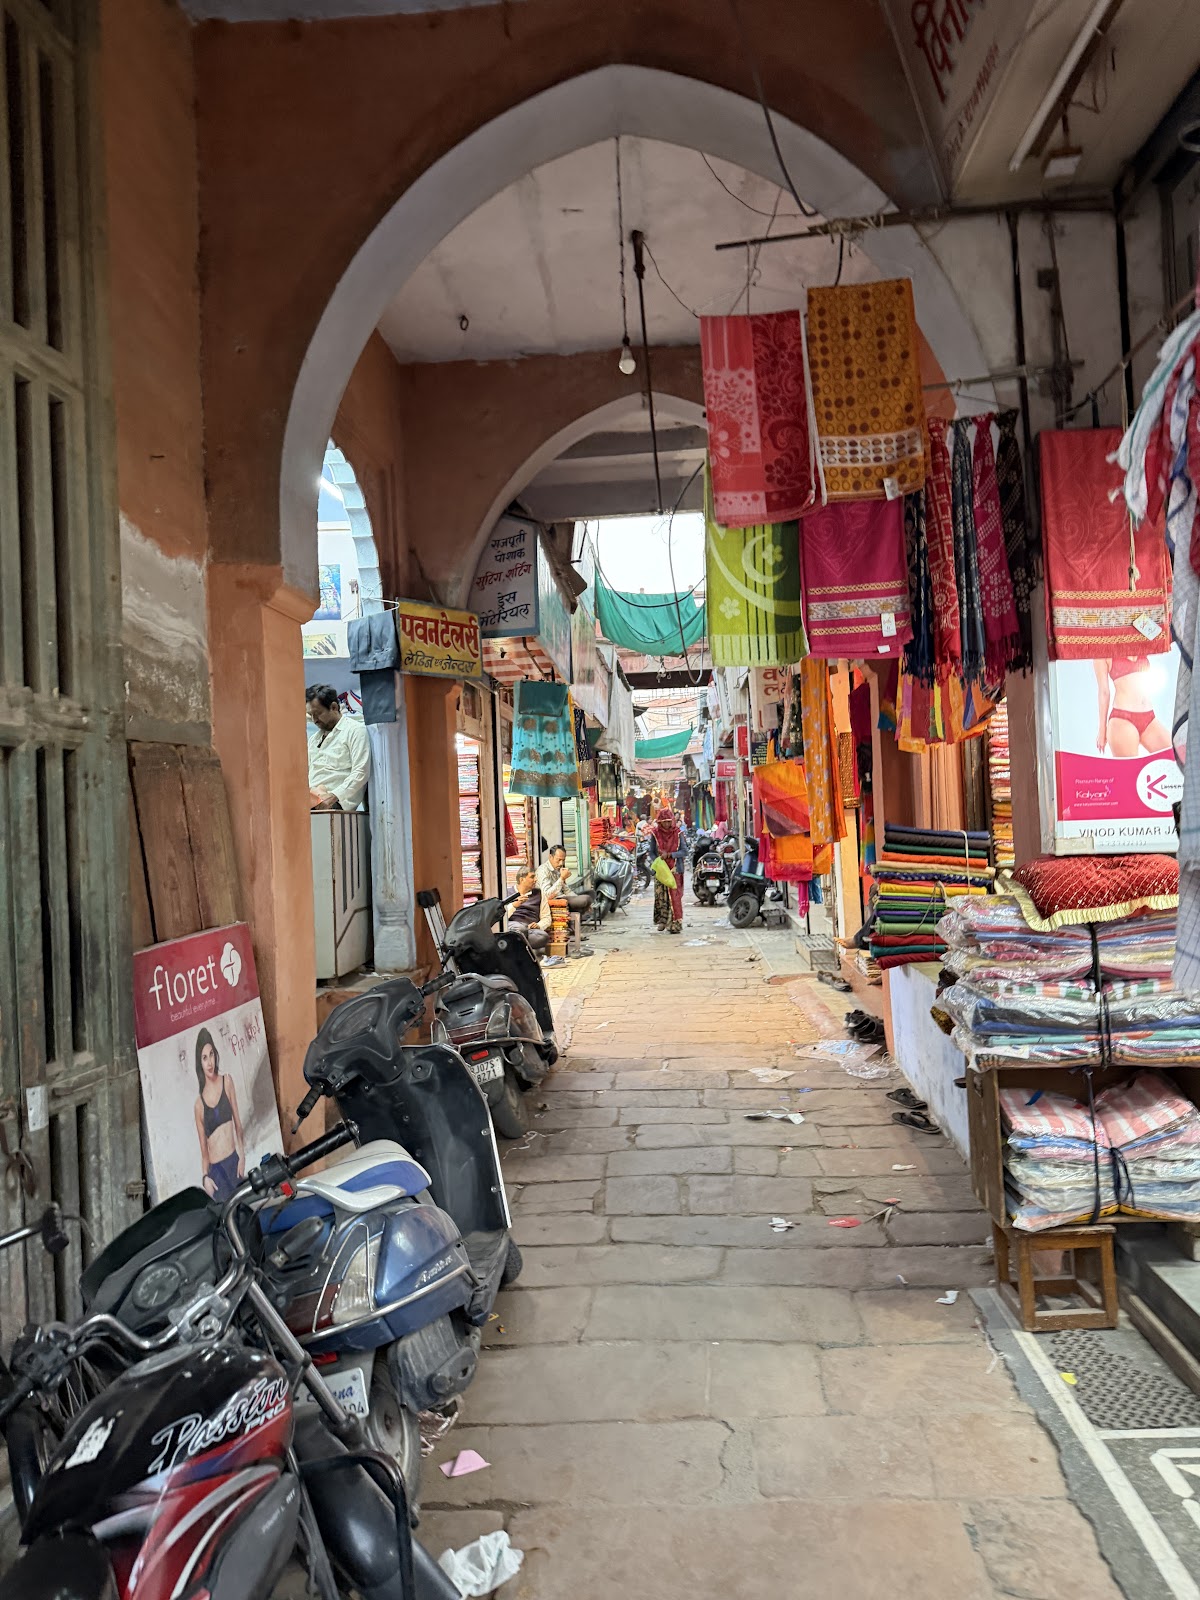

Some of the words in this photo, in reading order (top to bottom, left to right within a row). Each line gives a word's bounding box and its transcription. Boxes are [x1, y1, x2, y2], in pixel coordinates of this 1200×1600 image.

[491, 529, 527, 549] राजपूती
[494, 547, 525, 562] पोशाक
[497, 591, 517, 609] ड्रेस
[480, 603, 531, 627] मेटेरियल
[1076, 788, 1109, 800] Kalyani
[1079, 828, 1115, 838] VINOD
[1119, 826, 1161, 837] KUMAR
[148, 955, 218, 1011] floret
[477, 1068, 497, 1083] 8271
[244, 1399, 286, 1435] PRO
[148, 1377, 289, 1477] Passion
